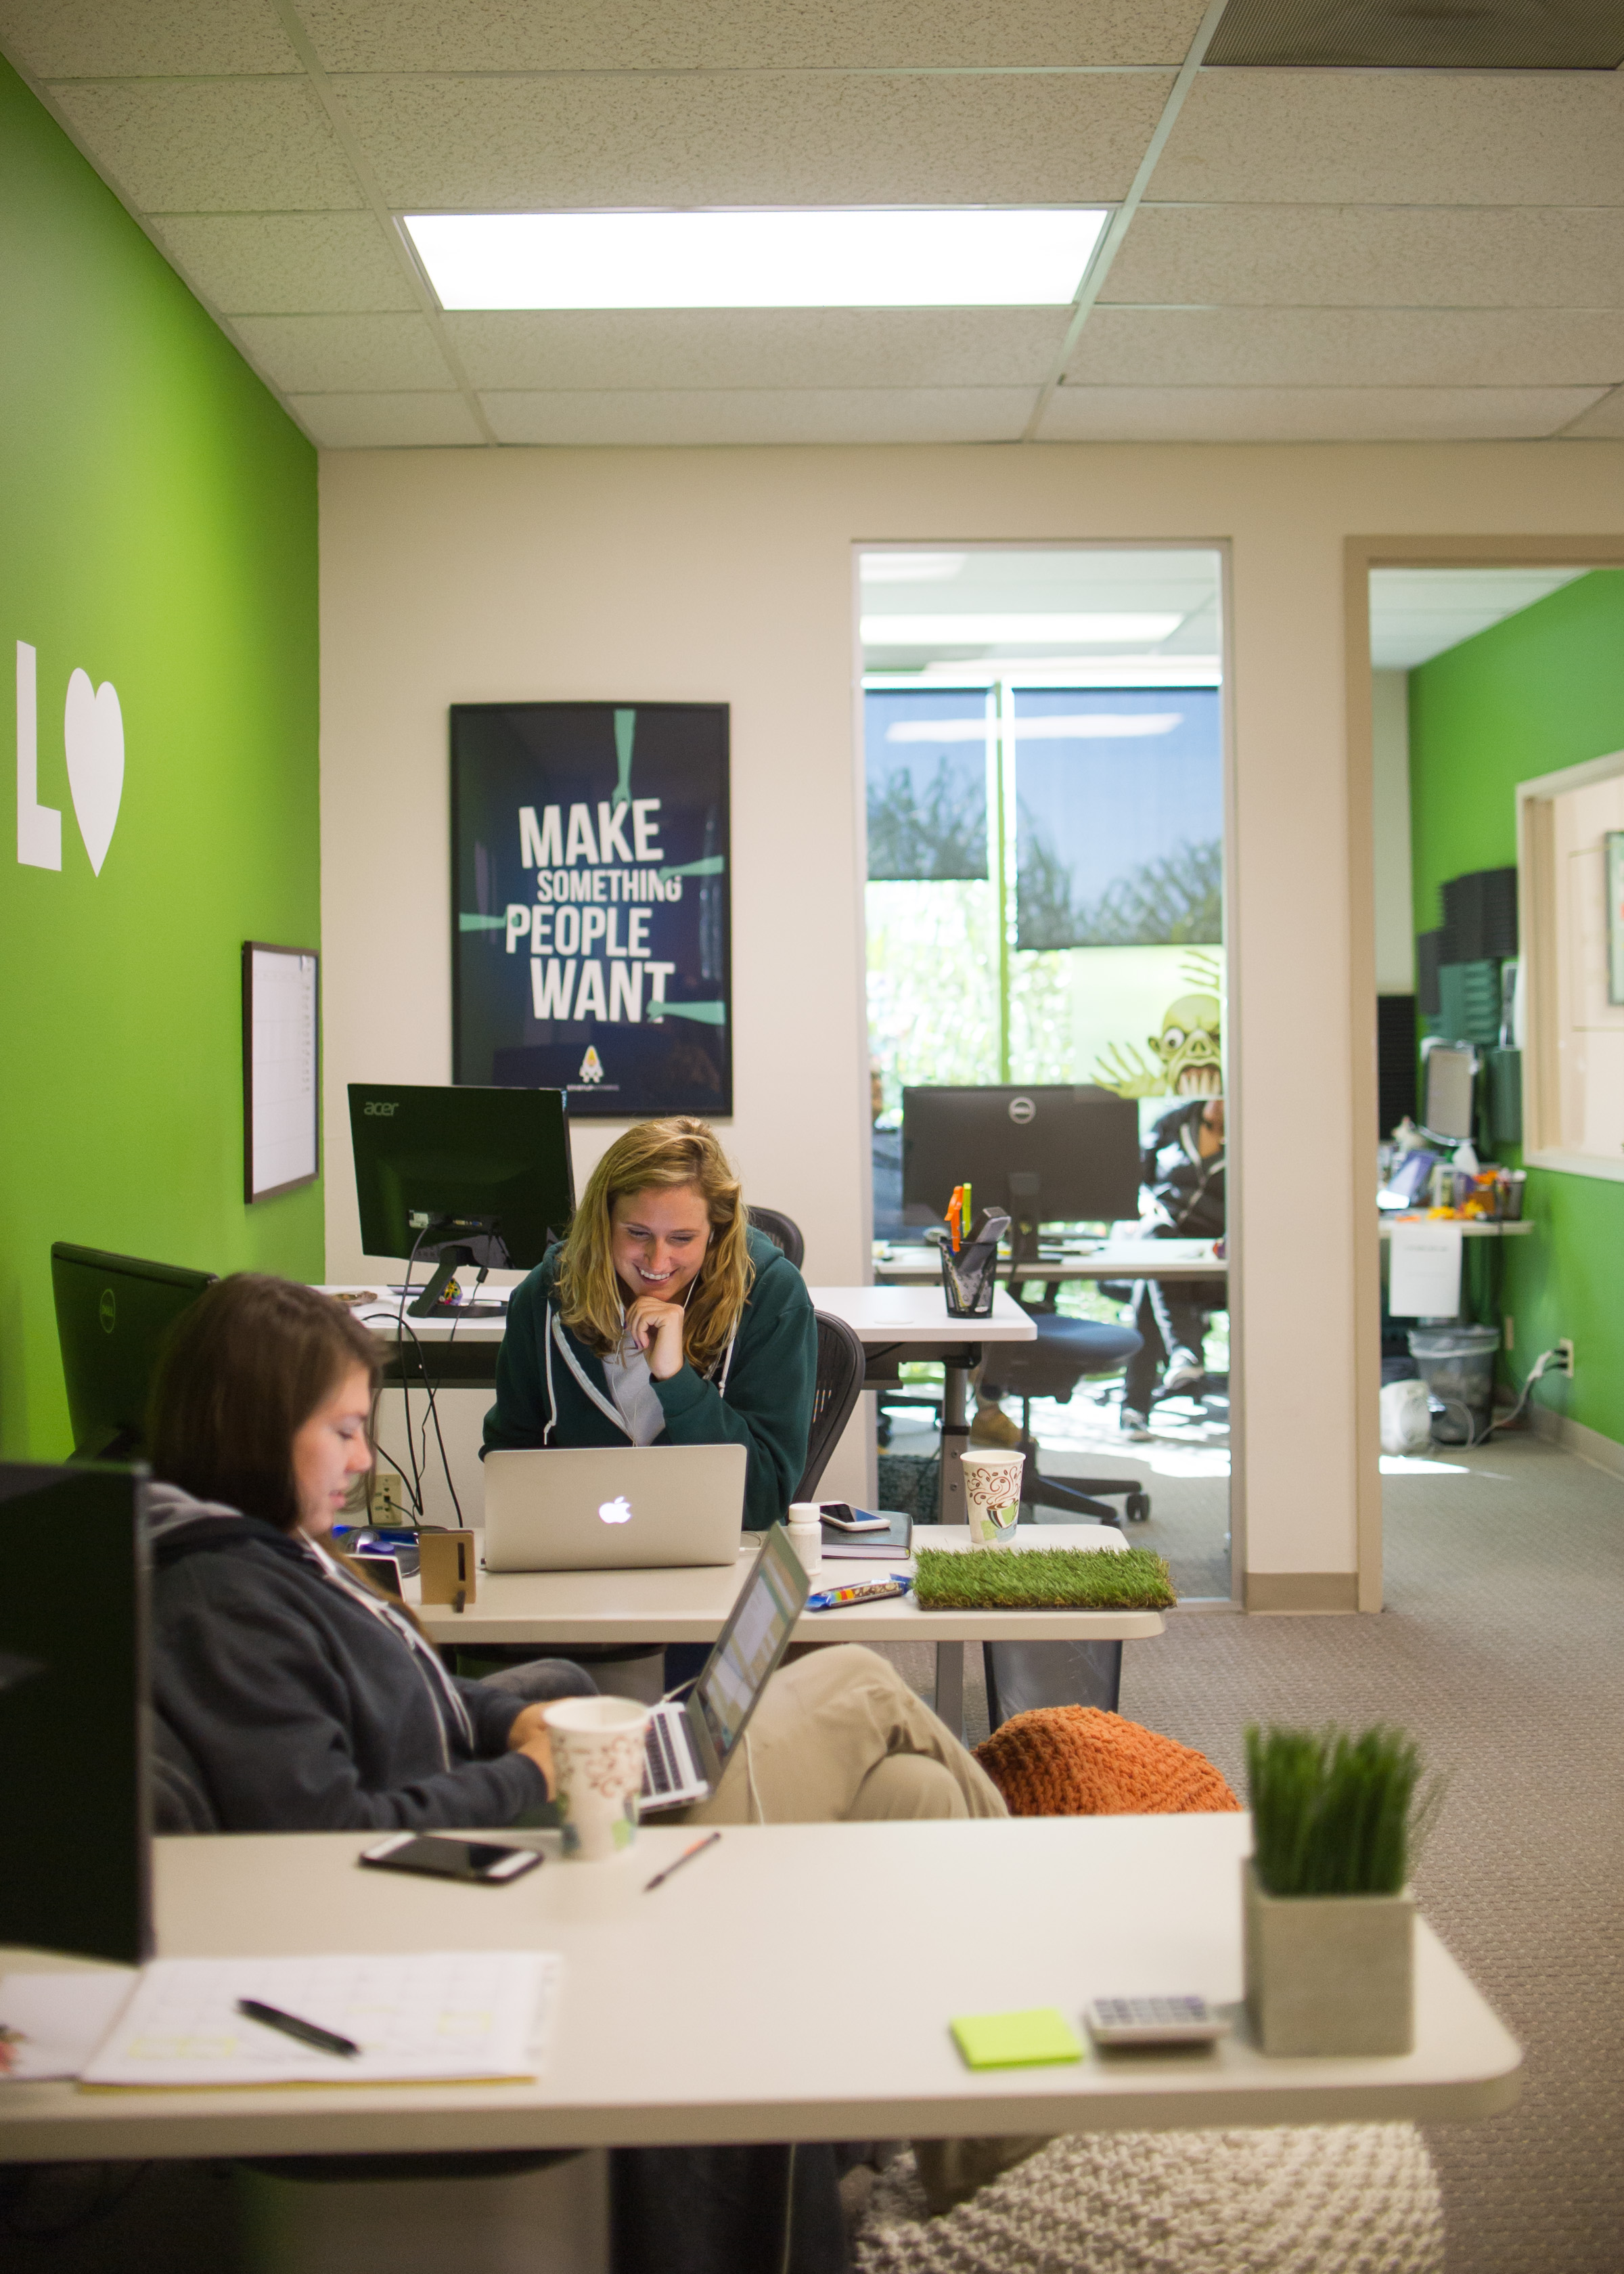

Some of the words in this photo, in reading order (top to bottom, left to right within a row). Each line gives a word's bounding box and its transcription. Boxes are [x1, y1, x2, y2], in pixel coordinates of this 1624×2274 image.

[17, 640, 62, 872] L
[518, 799, 664, 868] MAKE
[537, 868, 682, 902] SOMETHING
[505, 904, 652, 958] PEOPLE
[530, 958, 675, 1024] WANT
[364, 1102, 399, 1116] acer
